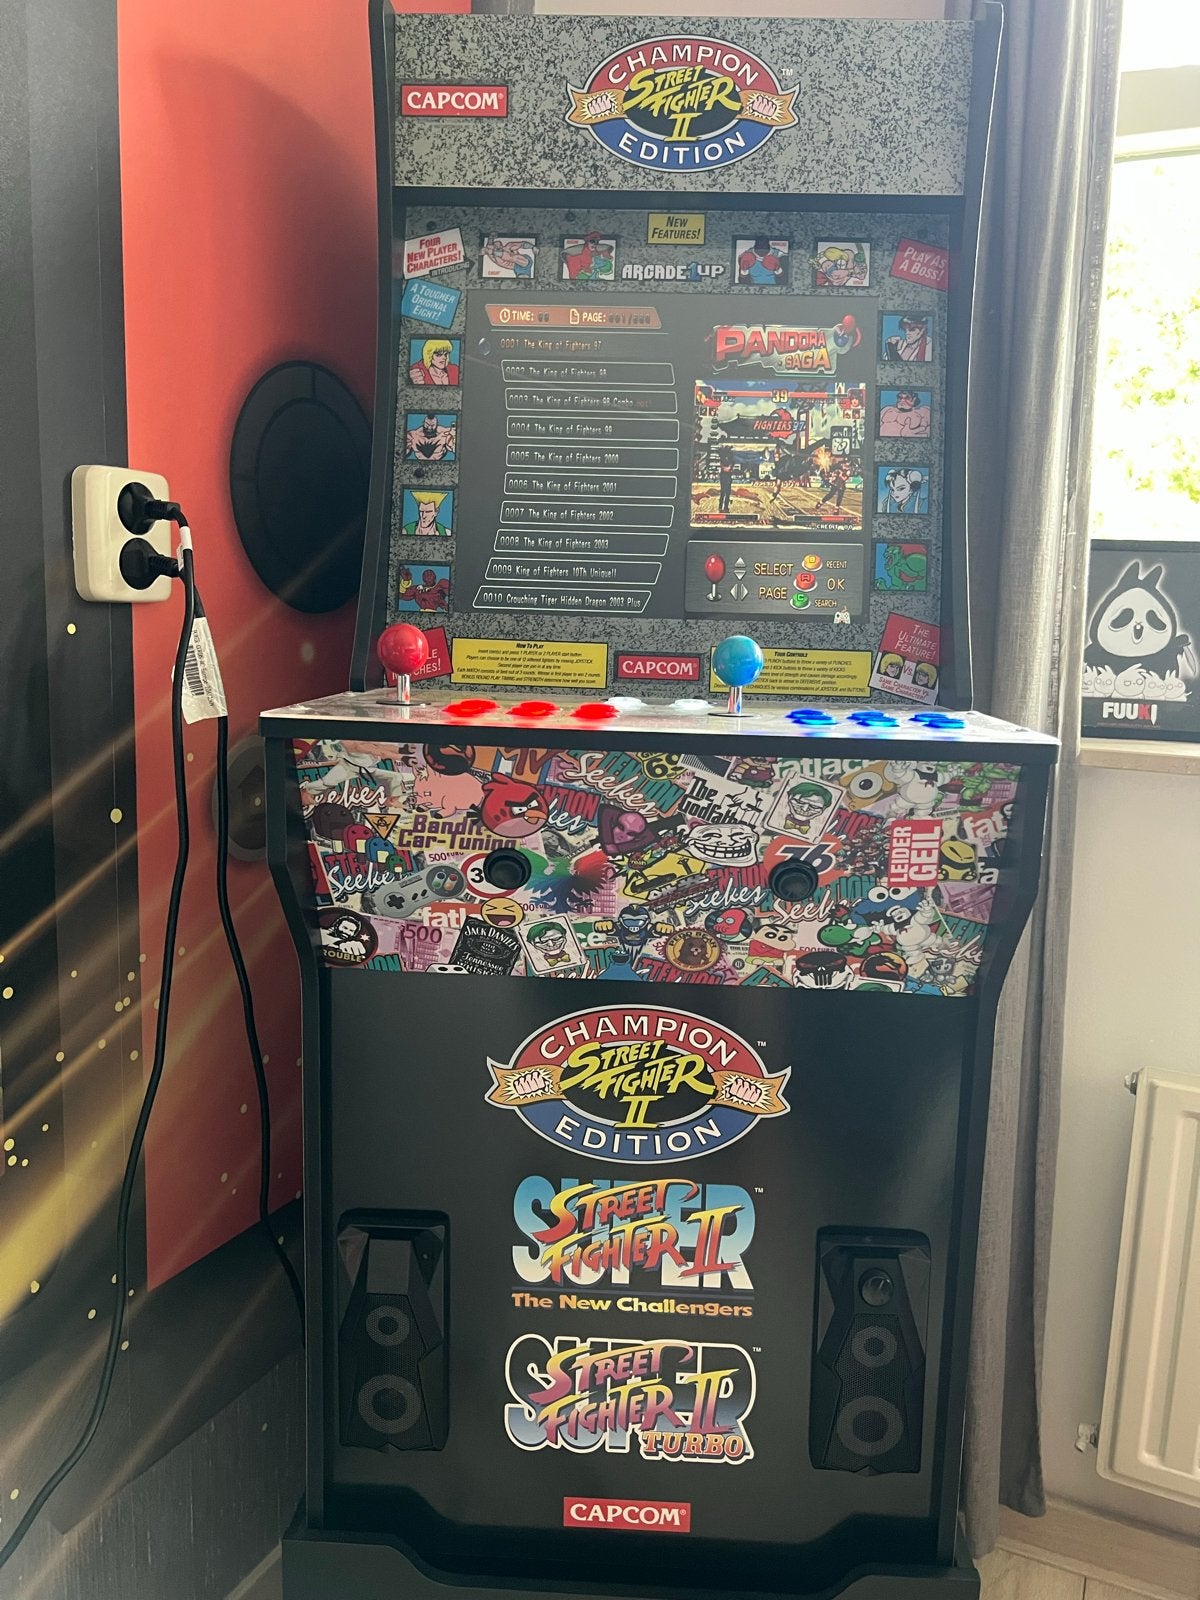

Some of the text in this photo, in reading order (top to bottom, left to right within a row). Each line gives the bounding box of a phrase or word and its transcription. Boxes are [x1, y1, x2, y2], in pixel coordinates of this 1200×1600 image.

[608, 44, 759, 85] CHAMPION
[781, 68, 793, 76] TM
[623, 65, 703, 111] STREET
[639, 77, 741, 117] FIGHTER
[407, 91, 499, 110] CAPCOM
[664, 113, 702, 142] II
[619, 132, 746, 164] EDITION
[666, 216, 689, 228] NEW
[420, 237, 441, 250] FOUR
[651, 228, 701, 240] FEATURES!
[407, 243, 458, 263] NEW PLAYER
[407, 250, 461, 273] CHARACTERS!
[904, 246, 946, 268] PLAY AS
[899, 261, 945, 281] A BOSS!
[410, 283, 456, 302] A TOUGHER
[412, 294, 447, 312] ORIGINAL
[413, 305, 442, 320] EIGHT!
[512, 310, 534, 321] TIME:
[582, 311, 606, 322] PAGE:
[715, 325, 827, 363] PANDORA
[785, 348, 831, 370] SAGA
[771, 387, 788, 404] 39
[754, 560, 848, 576] SELECT RECENT
[758, 587, 787, 600] PAGE
[827, 578, 846, 591] OK
[506, 592, 538, 605] Crouching
[540, 594, 557, 606] Tiger
[560, 595, 582, 604] Hidden
[585, 596, 607, 606] Dragon
[627, 597, 641, 608] Plus
[814, 599, 838, 608] SEARCH
[898, 630, 937, 650] ULTIMATE
[913, 624, 930, 637] THE
[895, 640, 937, 660] FEATURE!
[622, 660, 694, 676] CAPCOM
[690, 776, 719, 801] The
[429, 853, 447, 862] 500
[890, 826, 912, 882] LEIDER
[908, 826, 941, 881] GEIL
[470, 868, 484, 883] 3
[540, 1015, 737, 1067] CHAMPION
[559, 1040, 666, 1092] STREET
[582, 1054, 716, 1099] FIGHTER
[614, 1095, 664, 1129] II
[555, 1115, 722, 1154] EDITION
[532, 1179, 699, 1243] STREET
[541, 1204, 745, 1284] FIGHTER II
[512, 1292, 753, 1317] The New Challengers
[528, 1342, 694, 1404] STREET
[537, 1378, 686, 1443] FIGHTER
[642, 1431, 744, 1458] TURBO
[570, 1503, 681, 1526] CAPCOM
